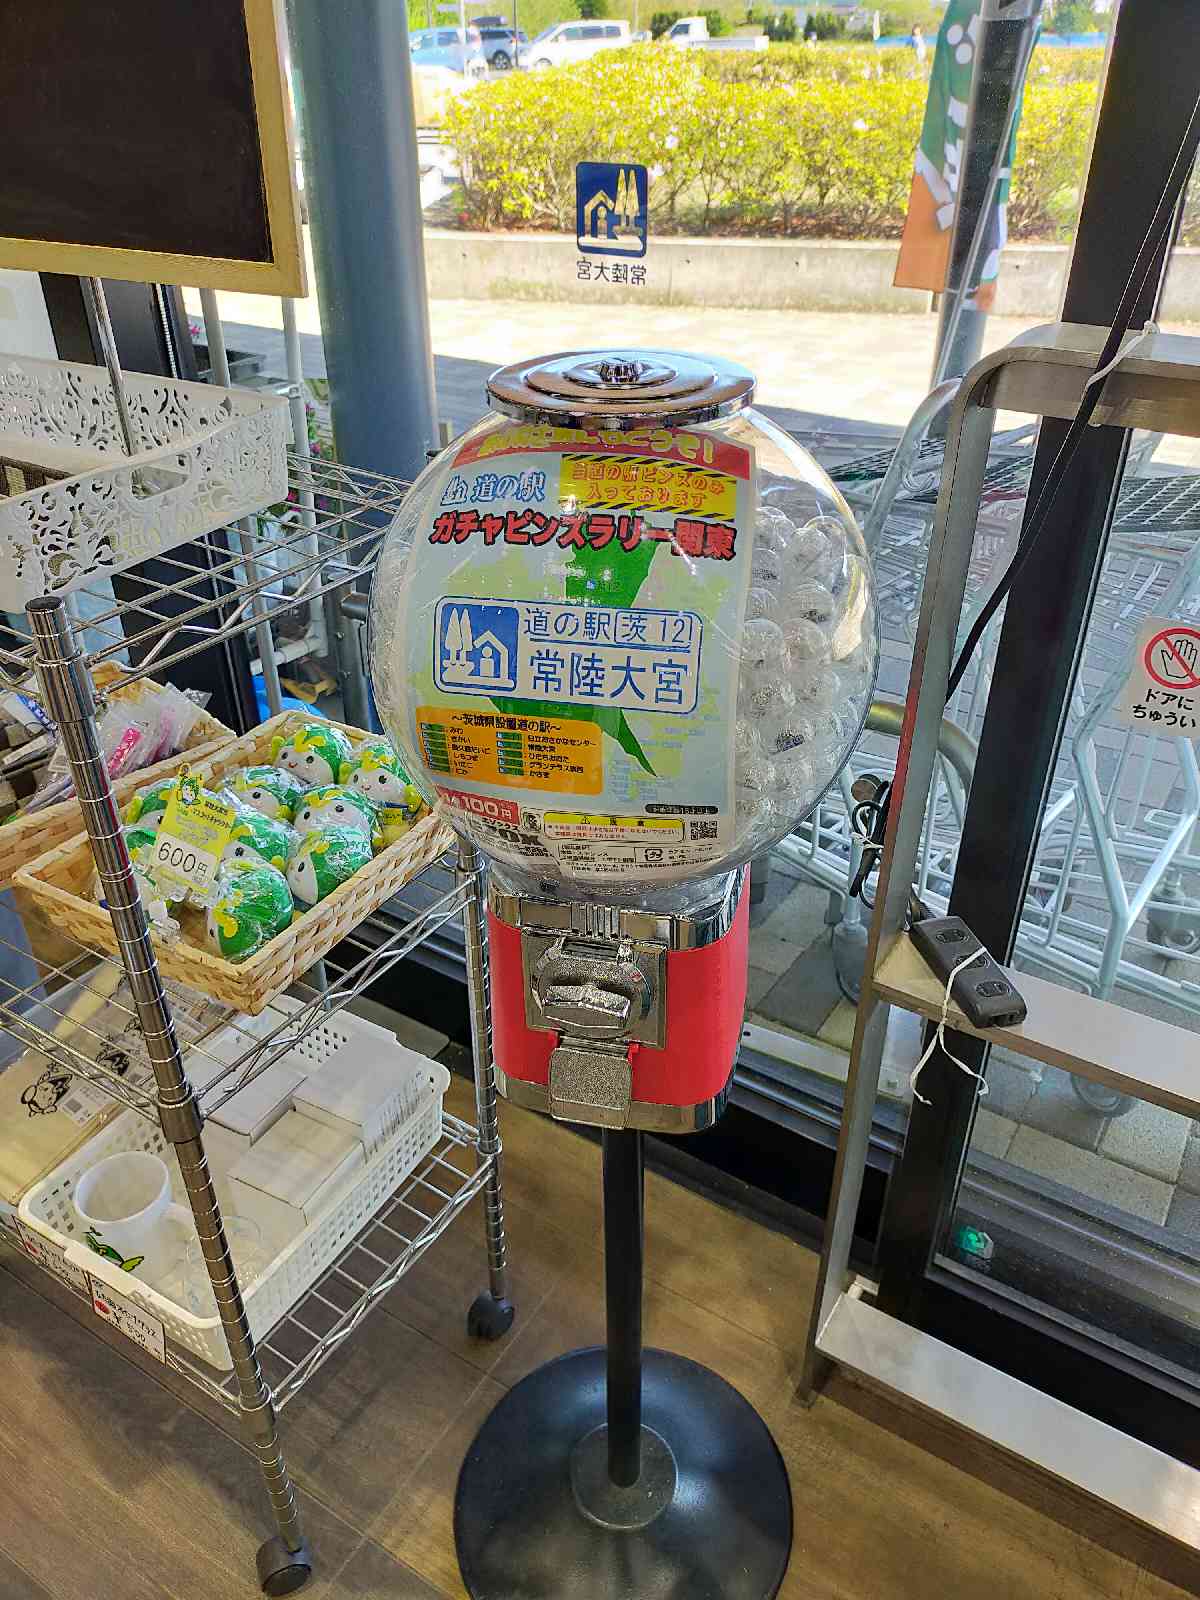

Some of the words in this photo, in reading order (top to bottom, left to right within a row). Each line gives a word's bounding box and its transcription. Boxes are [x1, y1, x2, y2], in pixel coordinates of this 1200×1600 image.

[471, 471, 546, 502] 道の駅
[587, 483, 707, 508] 入っております
[428, 508, 737, 560] ガチャピンズラリー関東
[524, 607, 611, 641] 道の駅
[621, 613, 648, 643] 茨
[661, 617, 685, 643] 12
[528, 649, 690, 705] 常陸大宮
[1145, 688, 1195, 711] ドアに
[1132, 704, 1196, 728] ちゅうい
[158, 842, 209, 876] 600円
